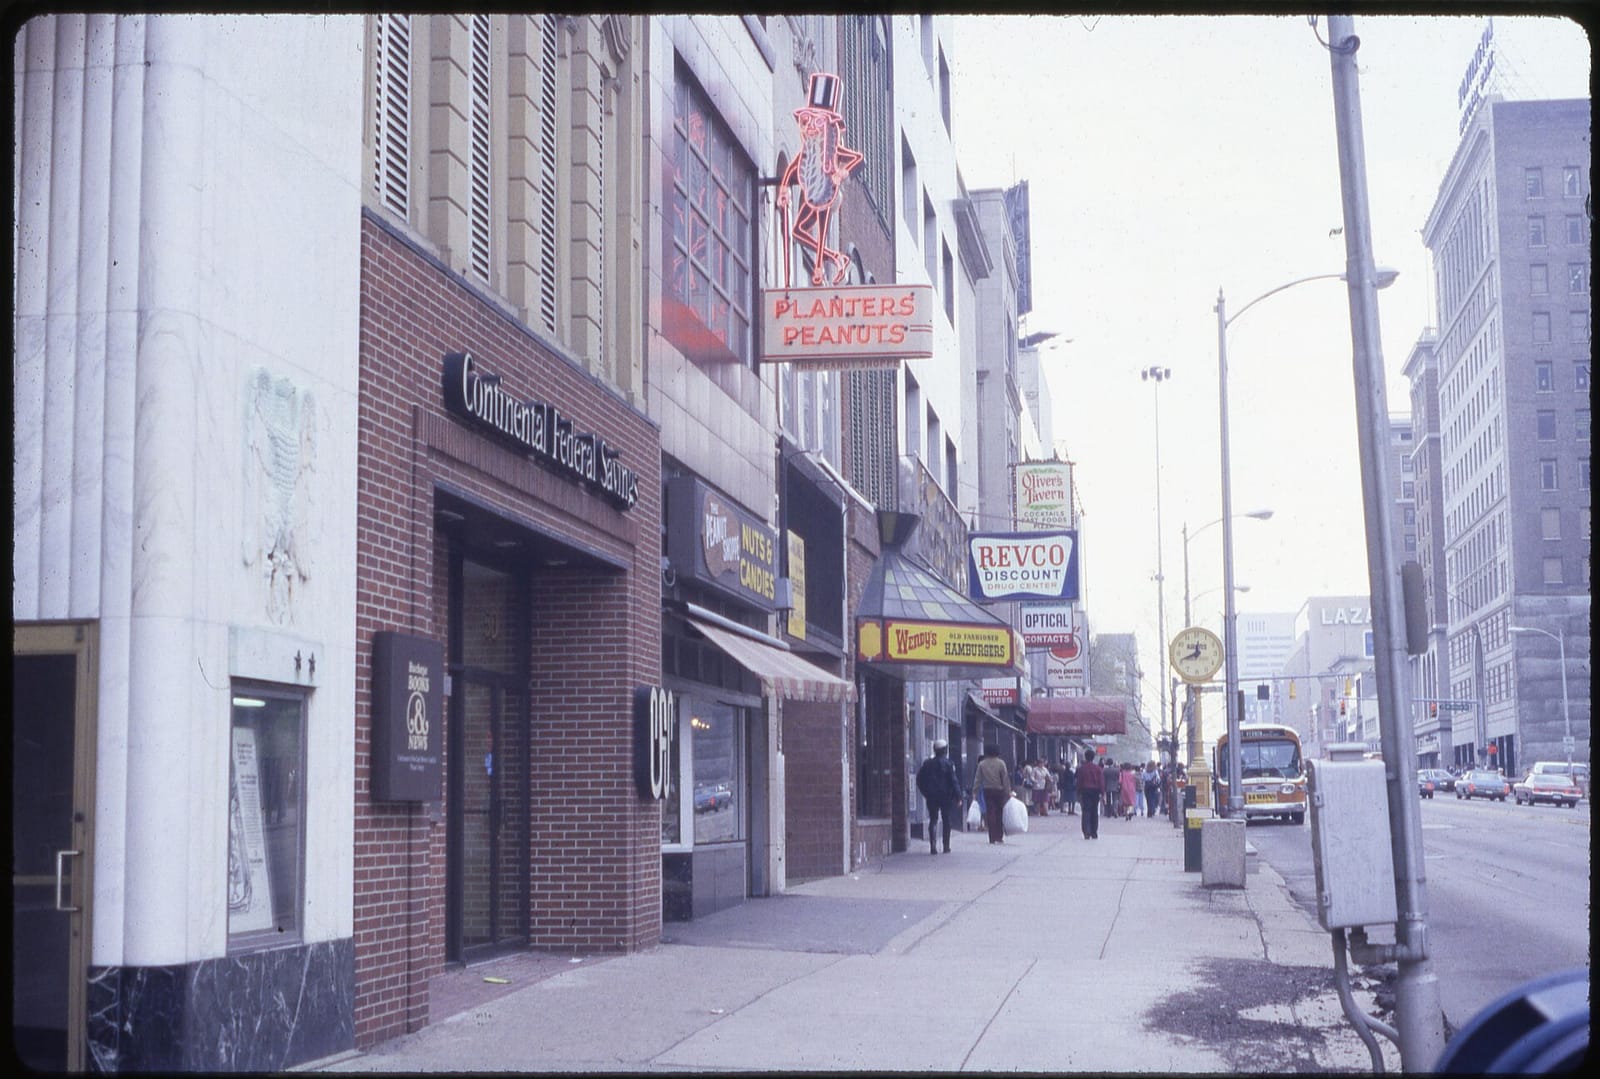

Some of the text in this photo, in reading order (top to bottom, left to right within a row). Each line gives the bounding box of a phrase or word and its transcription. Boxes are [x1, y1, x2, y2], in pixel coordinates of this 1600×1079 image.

[775, 296, 915, 319] PLANTERS
[783, 325, 906, 346] PEANUTS
[796, 363, 813, 371] THE
[816, 361, 856, 370] PEANUT
[462, 352, 639, 505] Continental Federal Savings
[1022, 472, 1064, 489] Oliver's
[1023, 487, 1065, 505] Tavern
[706, 514, 727, 549] PEANUT
[742, 523, 773, 565] NUTS &
[978, 544, 1065, 568] REVCO
[740, 558, 775, 601] CANDIES
[985, 569, 1061, 582] DISCOUNT
[987, 582, 1058, 591] DRUG CENTER
[1025, 613, 1069, 628] OPTICAL
[1025, 634, 1070, 644] CONTACTS
[944, 642, 1005, 657] HAMBURGERS
[408, 675, 430, 692] BOOKS
[408, 735, 428, 751] NEWS
